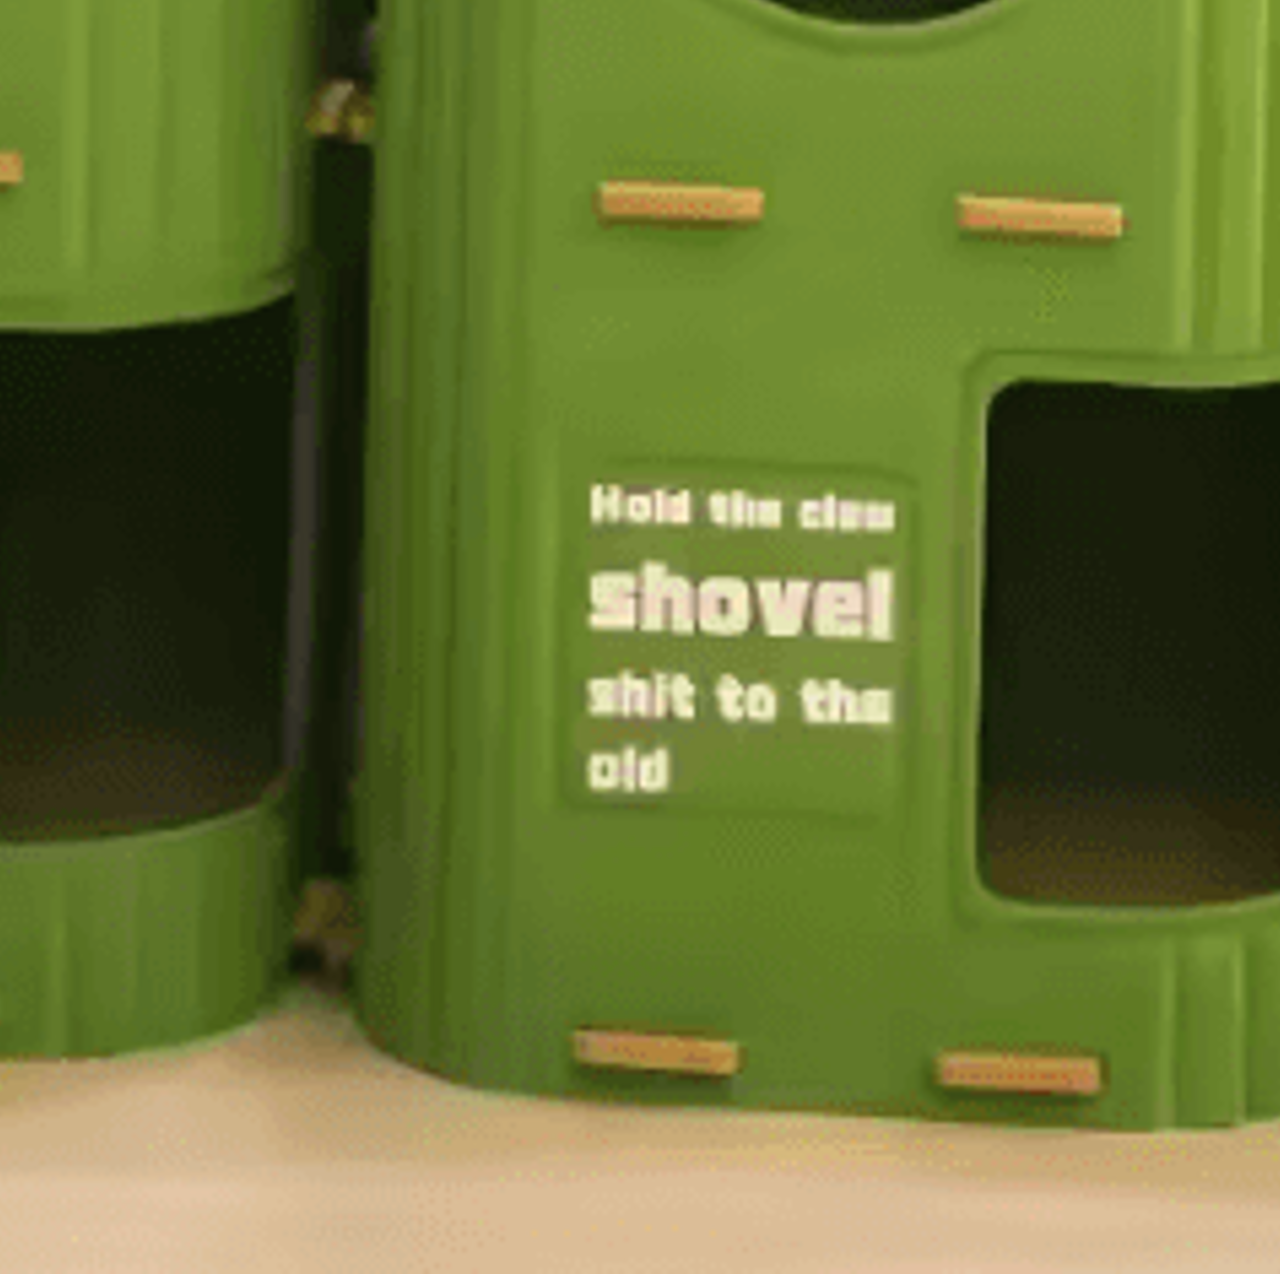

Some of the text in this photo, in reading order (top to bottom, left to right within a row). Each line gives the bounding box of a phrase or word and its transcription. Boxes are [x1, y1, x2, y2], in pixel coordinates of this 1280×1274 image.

[590, 484, 692, 525] Hold
[707, 489, 783, 529] the
[588, 560, 895, 642] shovel
[588, 670, 894, 725] shit to the
[587, 745, 670, 793] old
